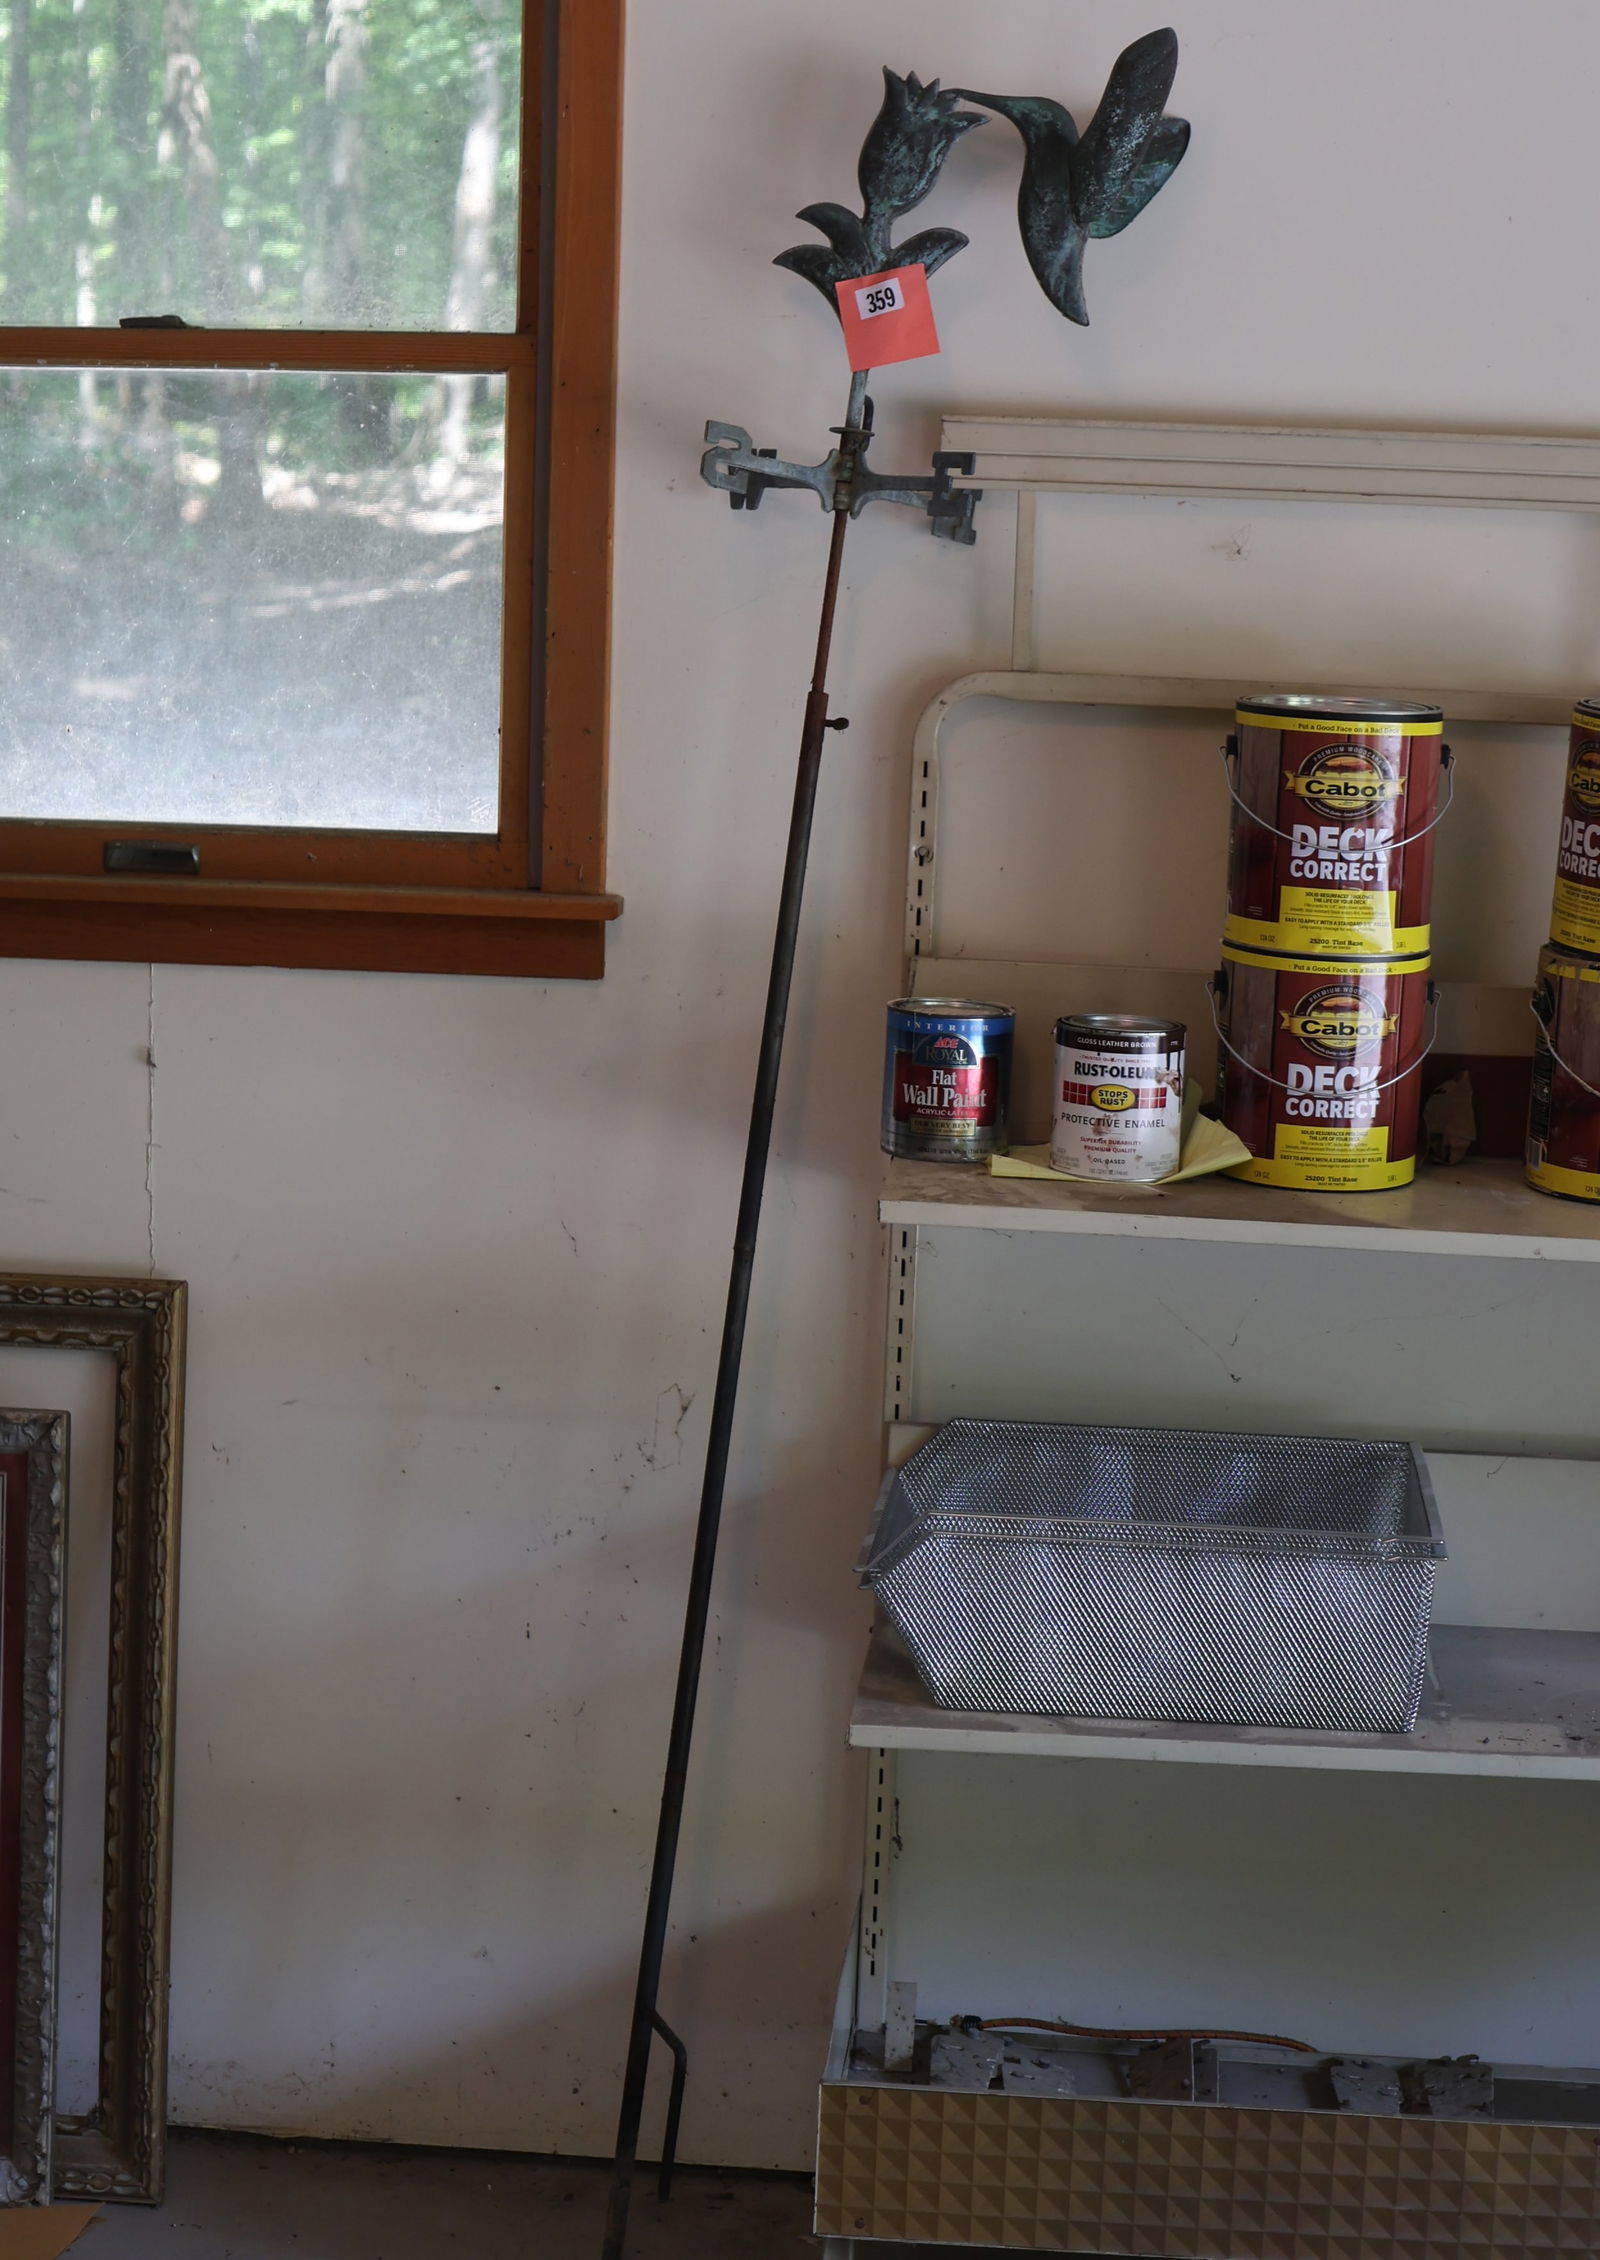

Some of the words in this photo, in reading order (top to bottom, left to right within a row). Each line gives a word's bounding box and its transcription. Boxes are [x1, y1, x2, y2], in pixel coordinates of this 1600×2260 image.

[866, 287, 896, 313] 359
[1313, 746, 1345, 762] PREMIUM
[1305, 780, 1386, 797] Cabot
[1291, 824, 1393, 861] DECK
[1290, 859, 1386, 882] CORRECT
[1559, 850, 1600, 878] CORRE
[1308, 987, 1340, 1003] PREMIUM
[907, 1020, 989, 1032] INTERIOR
[1301, 1020, 1380, 1036] Cabot
[934, 1037, 959, 1049] ACE
[1078, 1037, 1098, 1045] GLOSS
[1098, 1039, 1129, 1048] LEATHER
[1130, 1040, 1157, 1048] BROWN
[925, 1047, 967, 1061] ROYAL
[932, 1069, 957, 1086] Flat
[1286, 1063, 1383, 1099] DECK
[903, 1083, 938, 1107] Wall
[943, 1087, 986, 1108] Paint
[1098, 1090, 1128, 1099] STOPS
[1100, 1097, 1125, 1106] RUST
[1285, 1097, 1380, 1119] CORRECT
[1061, 1112, 1120, 1128] PROTECTIVE
[1125, 1119, 1165, 1128] ENAMEL
[1080, 1136, 1108, 1145] SUPERIOR
[1108, 1138, 1142, 1146] DURABILITY
[1112, 1146, 1137, 1154] QUALITY
